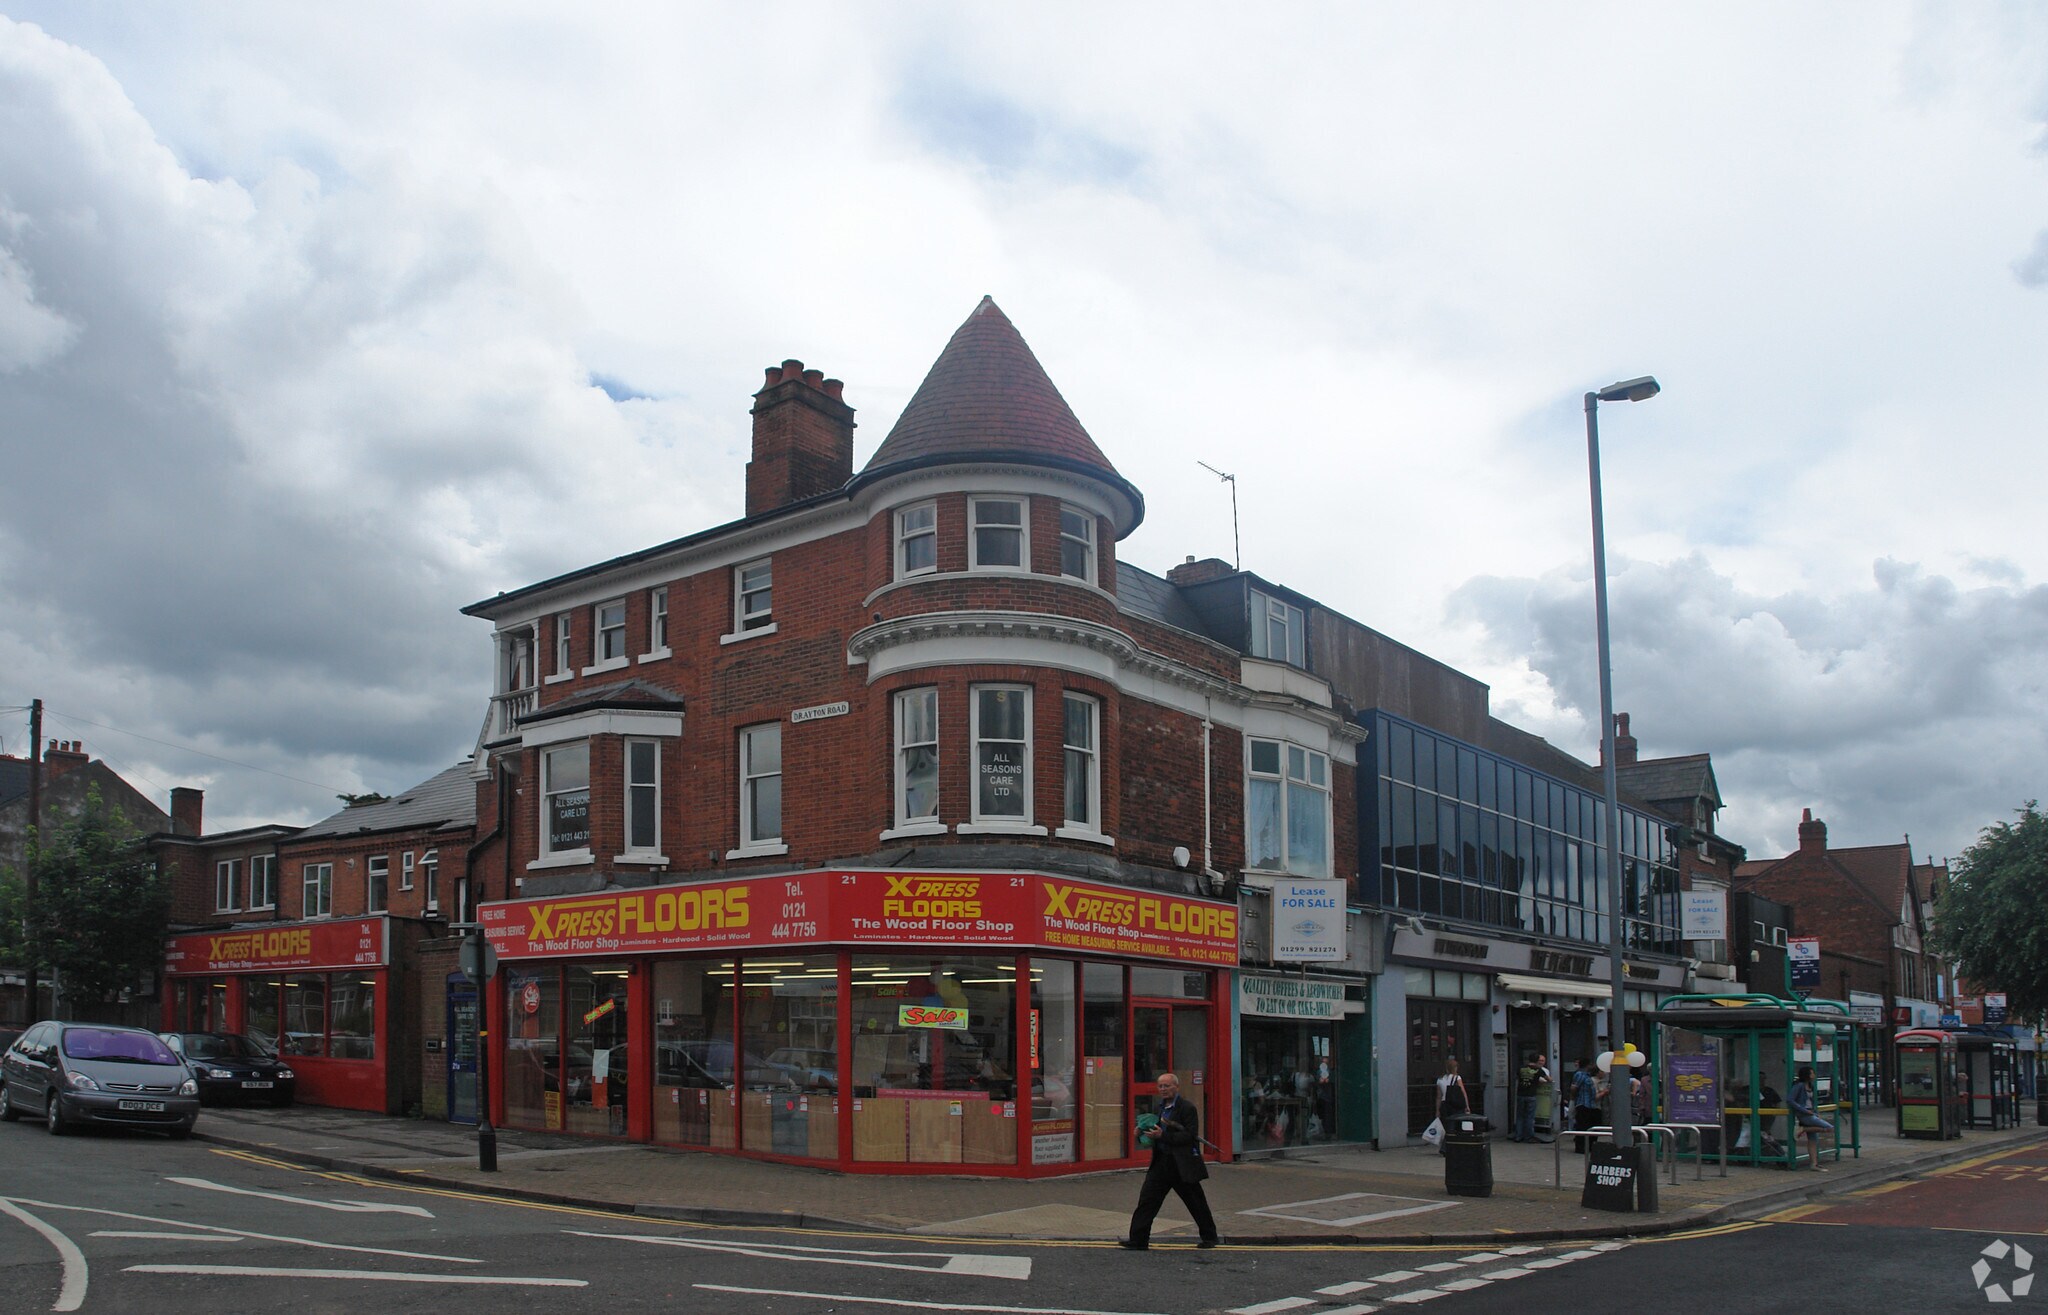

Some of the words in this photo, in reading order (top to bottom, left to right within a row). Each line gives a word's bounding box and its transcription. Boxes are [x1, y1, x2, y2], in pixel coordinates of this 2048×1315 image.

[793, 708, 826, 720] DRAYTON
[827, 704, 847, 714] ROAD
[993, 753, 1010, 763] ALL
[981, 765, 1022, 774] SEASONS
[989, 776, 1014, 785] CARE
[994, 787, 1010, 796] LTD
[560, 808, 575, 819] CARE
[576, 807, 586, 817] LTD
[841, 875, 856, 885] 21
[884, 876, 980, 898] XPRESS
[1009, 878, 1025, 887] 21
[784, 881, 803, 897] Tel.
[1291, 887, 1326, 896] Lease
[782, 902, 806, 919] 0121
[883, 899, 982, 918] FLOORS
[1043, 882, 1136, 927] XPRESS
[1139, 897, 1236, 939] FLOORS
[1282, 898, 1305, 908] FOR
[1306, 898, 1336, 908] SALE
[482, 910, 493, 920] FREE
[528, 903, 616, 940] XPRESS
[619, 886, 748, 935] FLOORS
[771, 922, 790, 939] 444
[792, 920, 817, 938] 7756
[851, 918, 881, 929] The
[885, 918, 927, 930] Wood
[932, 919, 971, 930] Floor
[975, 919, 1014, 933] Shop
[1043, 916, 1062, 929] The
[1064, 918, 1091, 932] Wood
[1092, 922, 1116, 936] Floor
[1117, 925, 1140, 940] Shop
[252, 930, 312, 957] FLOORS
[359, 938, 372, 953] 0121
[527, 941, 543, 952] The
[544, 939, 568, 951] Wood
[569, 938, 593, 950] Floor
[594, 936, 618, 950] Shop
[618, 937, 655, 946] Laminates
[661, 935, 698, 944] Hardwood
[705, 933, 725, 941] Solid
[727, 932, 749, 940] Wood
[1045, 931, 1061, 943] FREE
[1062, 932, 1080, 946] HOME
[1081, 934, 1116, 949] MEASURING
[1116, 939, 1141, 953] SERVICE
[1179, 946, 1191, 958] Tel.
[1192, 948, 1207, 960] 0121
[1208, 950, 1220, 961] 444
[1220, 951, 1236, 963] 7756
[1256, 997, 1266, 1013] TO
[1286, 999, 1296, 1015] OR
[1297, 1000, 1332, 1017] TAKE-AWAY
[904, 1007, 958, 1025] Sale
[1590, 1164, 1632, 1178] BARBERS
[1596, 1174, 1622, 1187] SHOP
